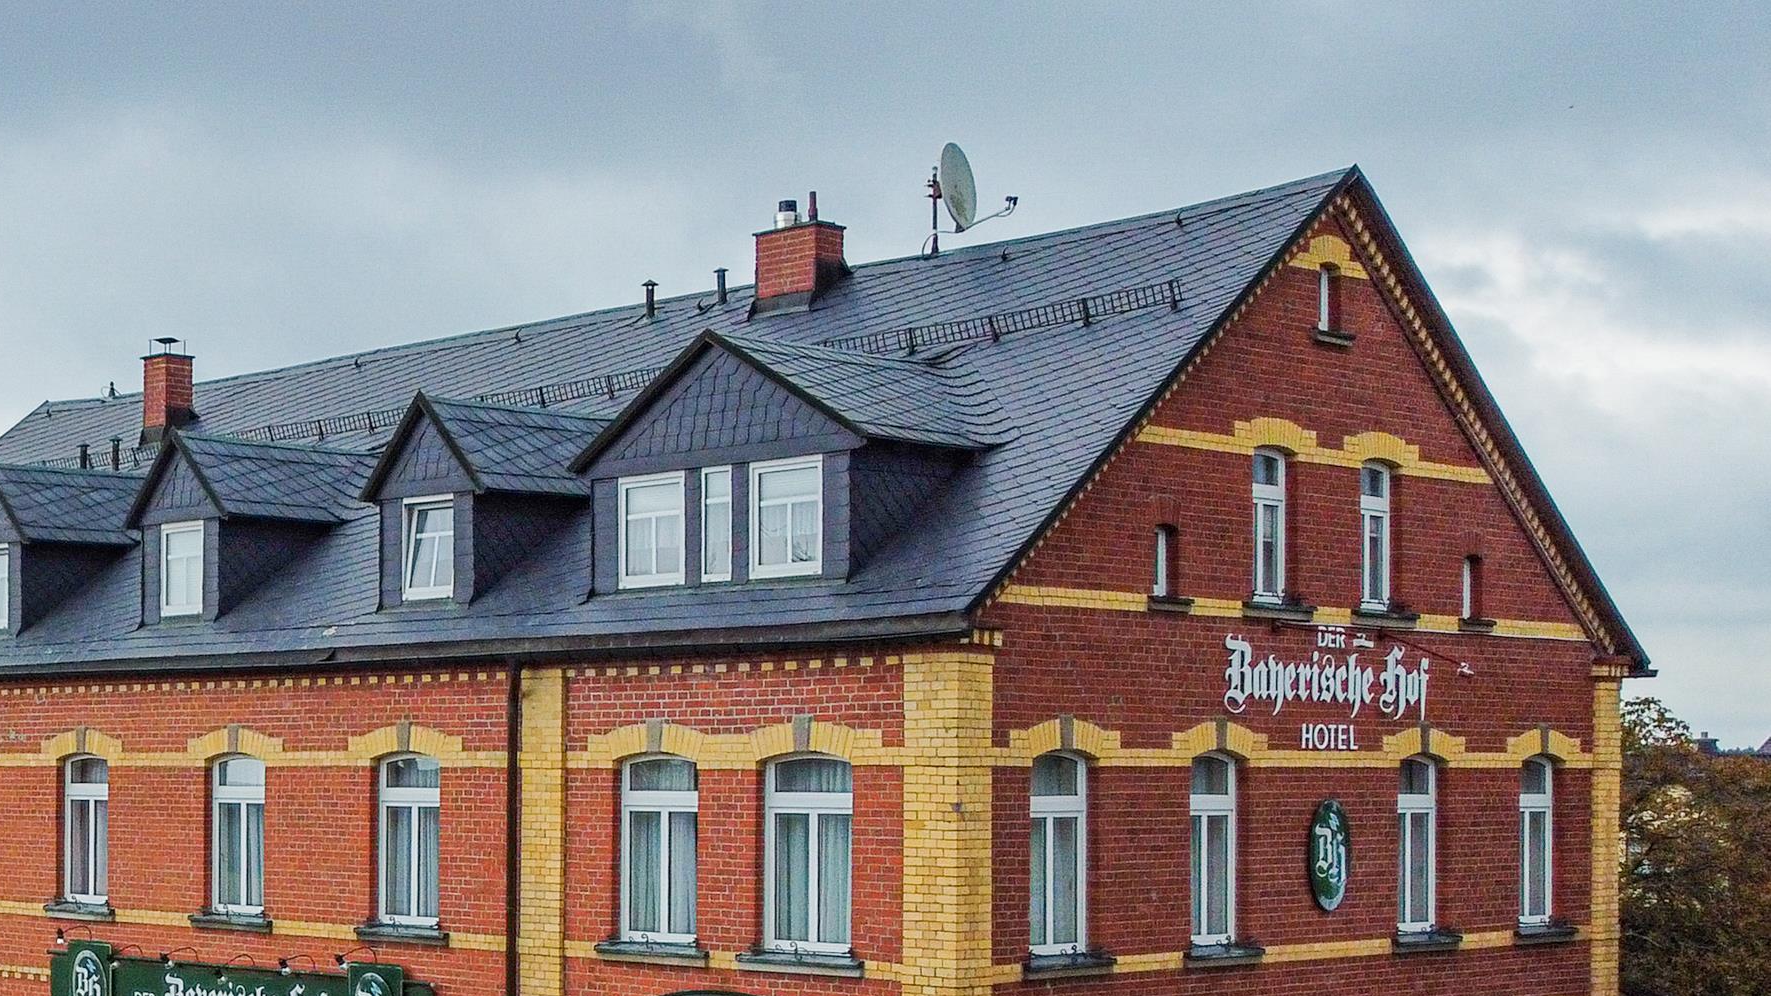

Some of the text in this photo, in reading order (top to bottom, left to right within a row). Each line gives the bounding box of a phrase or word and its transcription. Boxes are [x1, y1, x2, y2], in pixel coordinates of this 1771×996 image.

[1317, 625, 1346, 648] DER
[1224, 633, 1429, 721] Bayerische Hof
[1301, 723, 1359, 750] HOTEL
